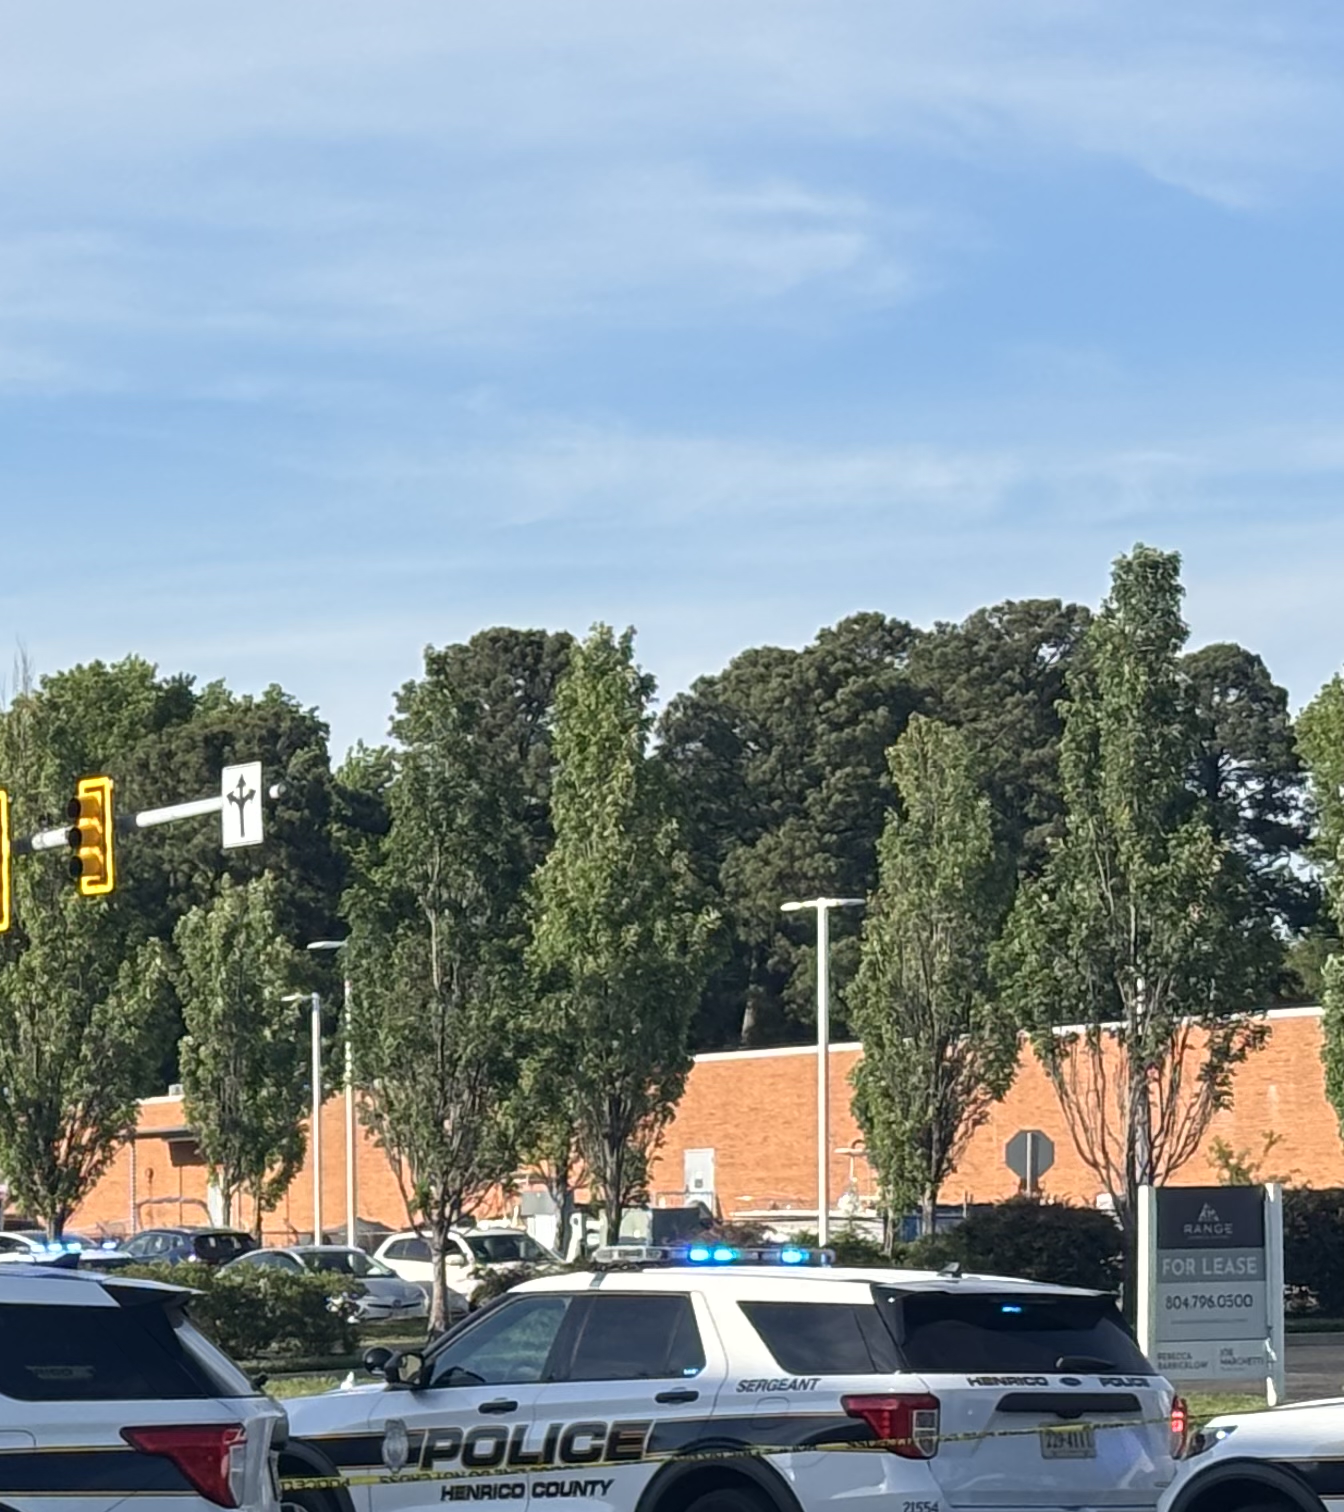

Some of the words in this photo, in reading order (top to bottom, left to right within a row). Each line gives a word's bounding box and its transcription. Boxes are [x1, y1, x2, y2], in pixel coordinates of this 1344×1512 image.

[1183, 1223, 1233, 1235] RANGE
[1162, 1258, 1196, 1276] FOR
[1202, 1256, 1258, 1276] LEASE
[1165, 1293, 1254, 1310] 804.796.0500
[736, 1377, 821, 1394] SERGEANT
[967, 1376, 1049, 1387] HENRICO
[1099, 1377, 1151, 1388] POLICE
[419, 1419, 655, 1471] POLICE
[440, 1481, 526, 1502] HENRICO
[531, 1479, 615, 1498] COUNTY
